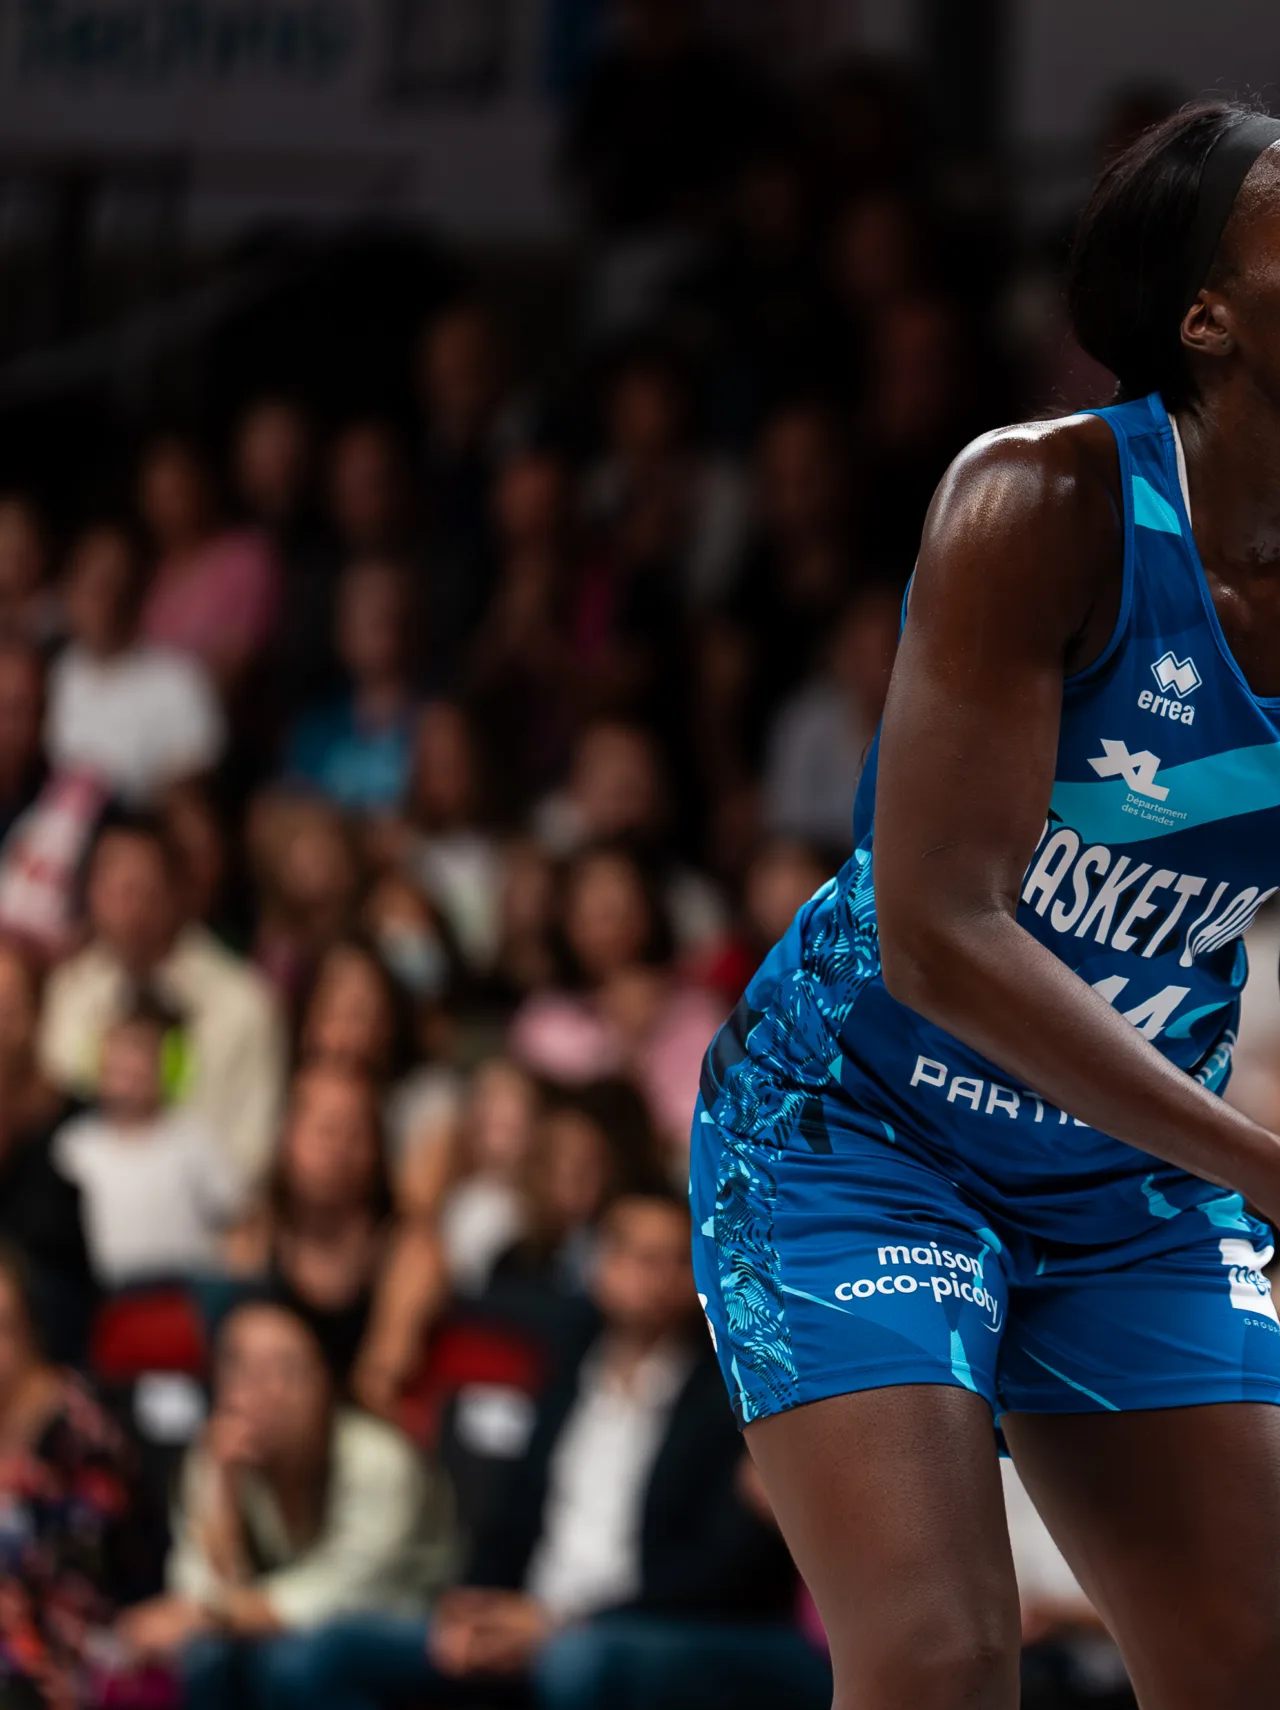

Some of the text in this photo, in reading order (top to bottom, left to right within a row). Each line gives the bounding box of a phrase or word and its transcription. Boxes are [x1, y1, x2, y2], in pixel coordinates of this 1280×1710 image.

[1121, 804, 1175, 827] des Landes
[1126, 793, 1188, 819] Département
[1021, 818, 1208, 959] ASKET
[909, 1055, 1091, 1128] PART
[877, 1241, 984, 1280] maison
[834, 1272, 998, 1324] coco-picoty
